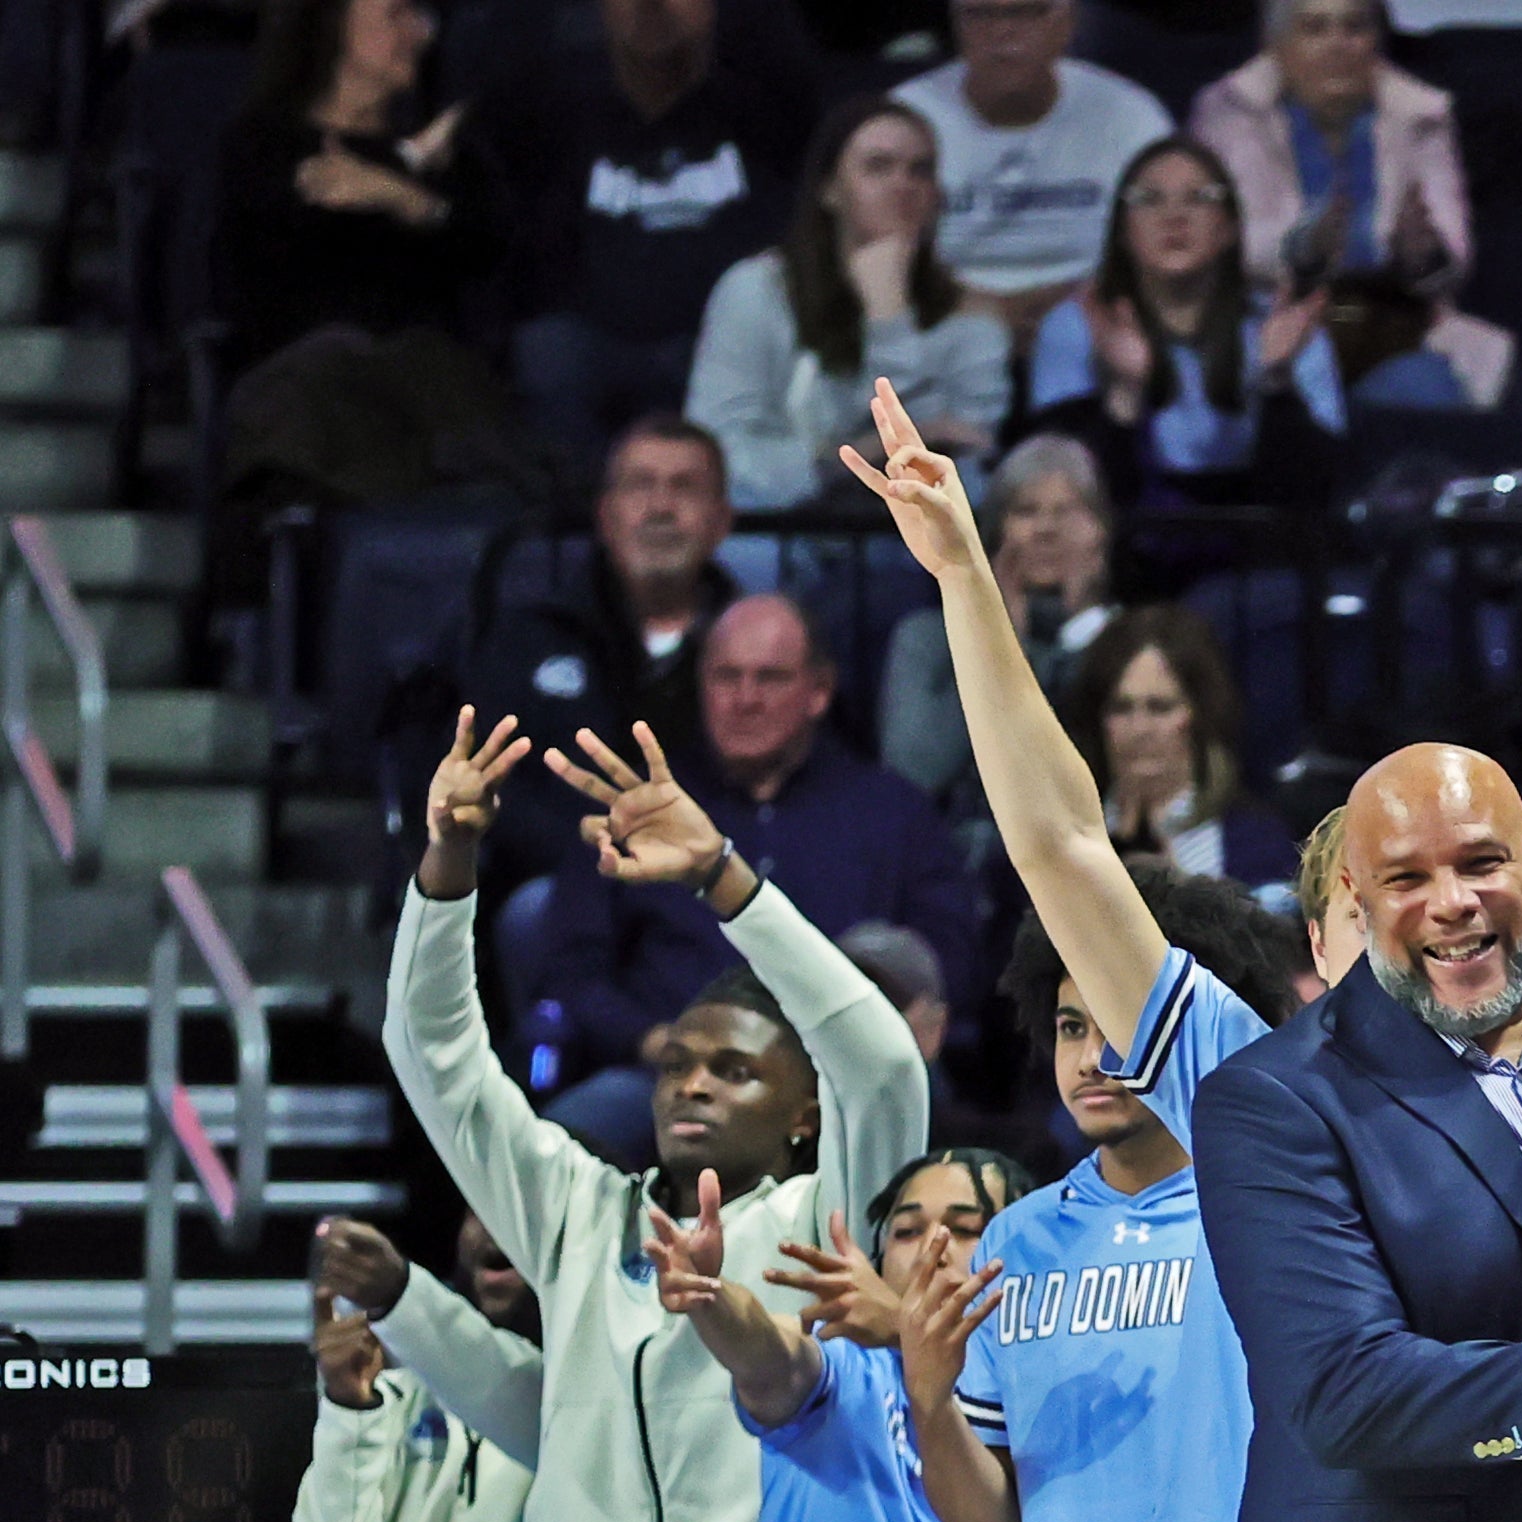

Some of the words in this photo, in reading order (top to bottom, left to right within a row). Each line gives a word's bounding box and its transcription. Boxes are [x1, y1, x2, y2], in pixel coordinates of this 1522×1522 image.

[998, 1269, 1068, 1347] OLD
[1069, 1256, 1195, 1335] DOMIN
[0, 1357, 151, 1390] ONICS
